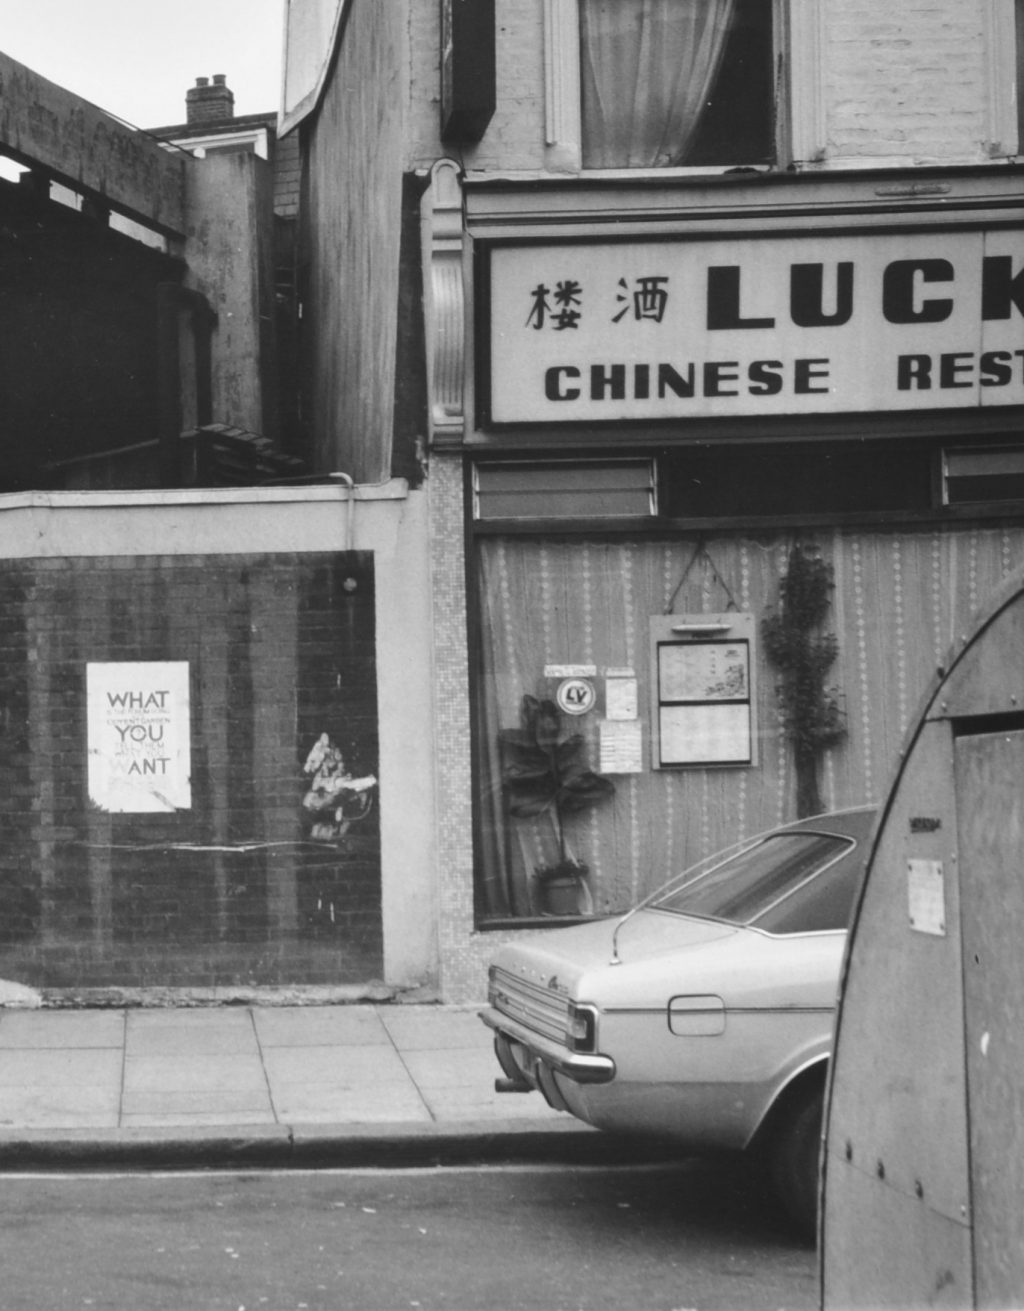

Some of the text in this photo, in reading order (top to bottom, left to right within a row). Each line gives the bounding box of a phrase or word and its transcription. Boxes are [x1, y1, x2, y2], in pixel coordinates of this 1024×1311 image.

[706, 254, 1024, 331] LUCK
[544, 349, 1024, 402] CHINESE RES
[107, 690, 170, 708] WHAT
[115, 724, 164, 743] YOU
